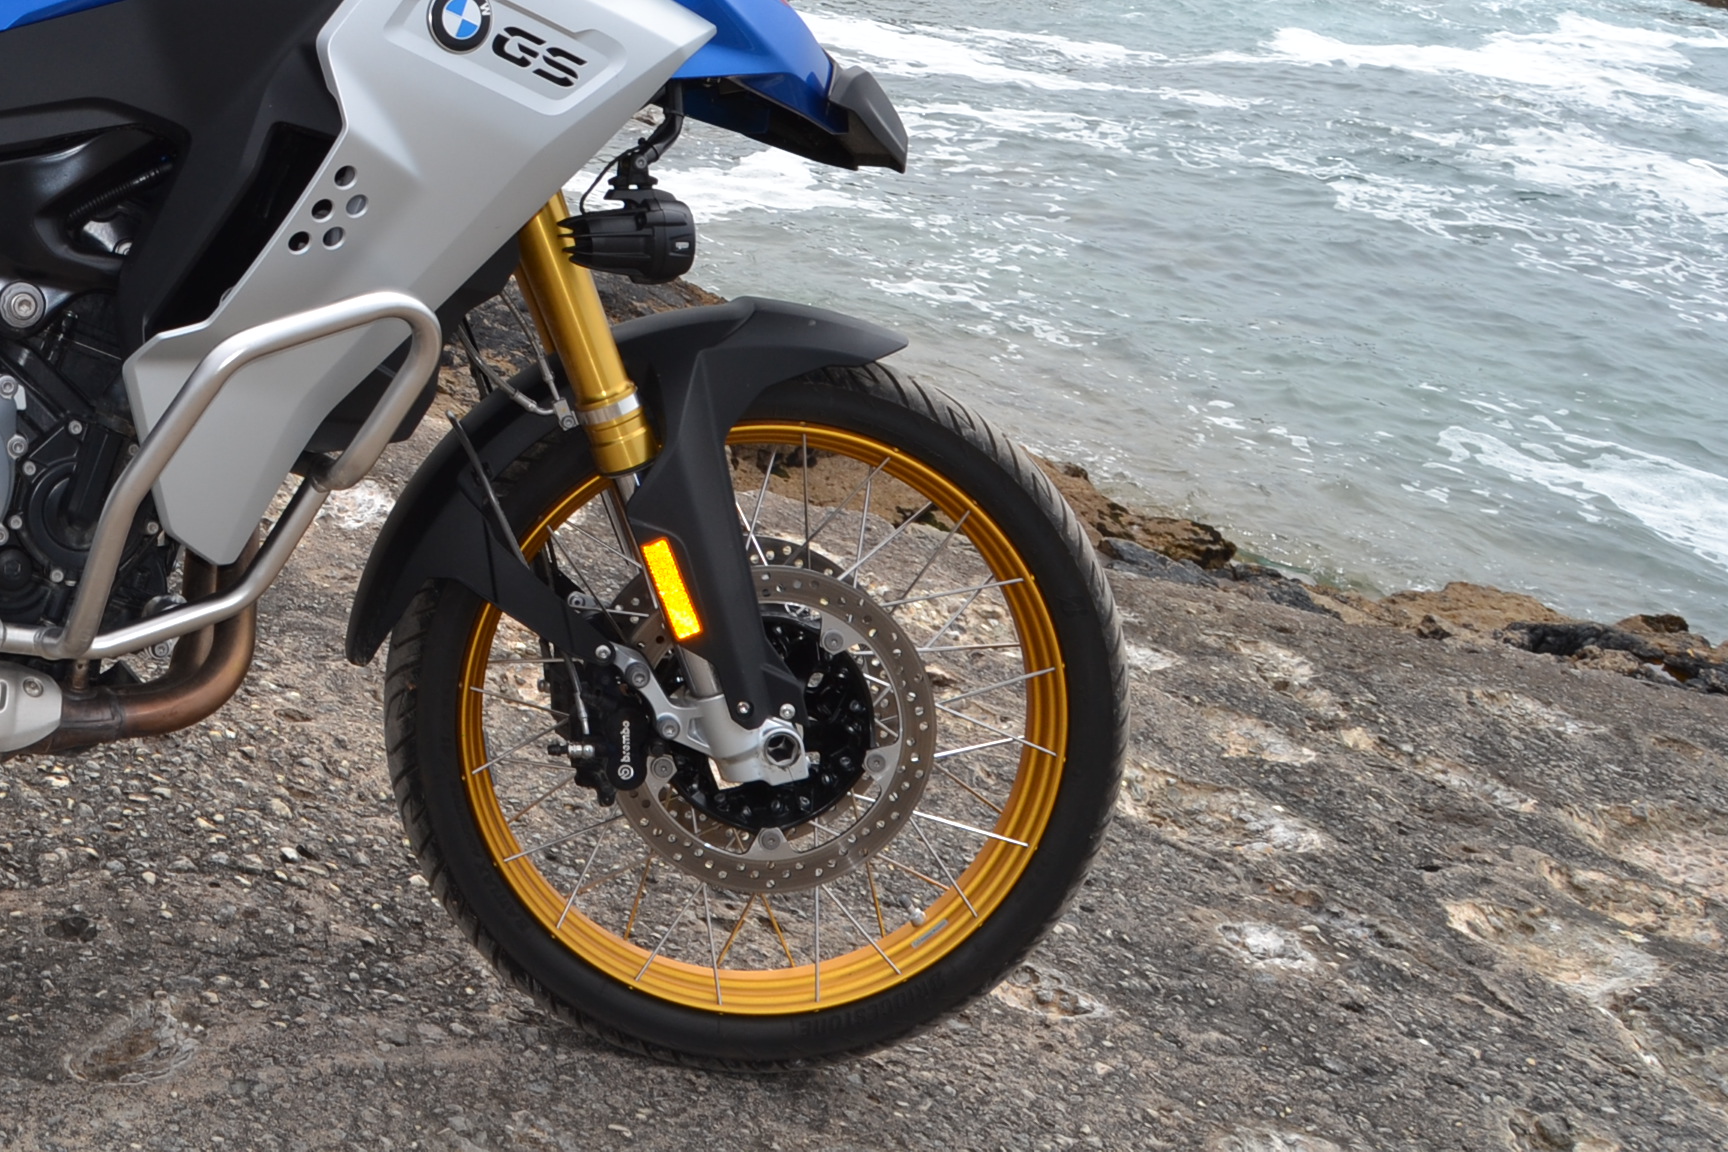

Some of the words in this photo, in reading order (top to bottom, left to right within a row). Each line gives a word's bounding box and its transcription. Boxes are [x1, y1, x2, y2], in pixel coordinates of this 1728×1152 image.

[491, 26, 588, 88] GS
[619, 719, 631, 763] brembo
[798, 970, 945, 1039] BRIDGESTONE
